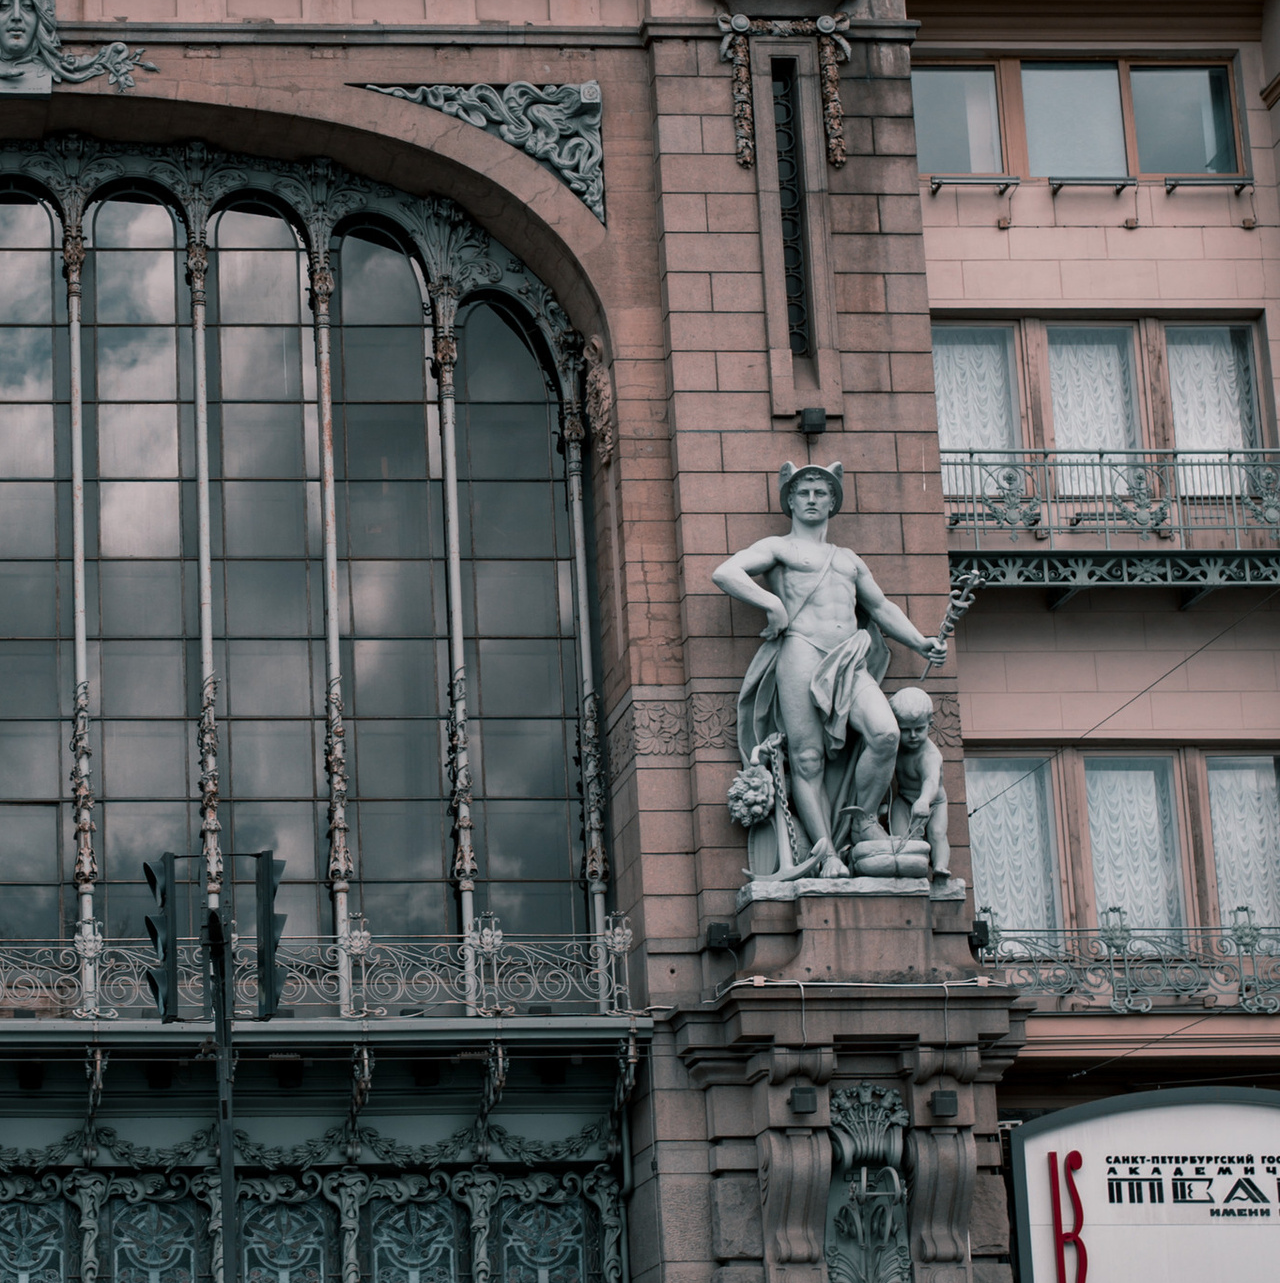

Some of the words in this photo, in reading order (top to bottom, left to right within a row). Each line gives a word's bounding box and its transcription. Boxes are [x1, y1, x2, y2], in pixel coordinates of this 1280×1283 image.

[1106, 1154, 1254, 1164] САНКТ-ПЕТЕРБУРГСКИЙ
[1107, 1178, 1280, 1204] ТЕА
[1210, 1208, 1271, 1217] ИМЕНИ
